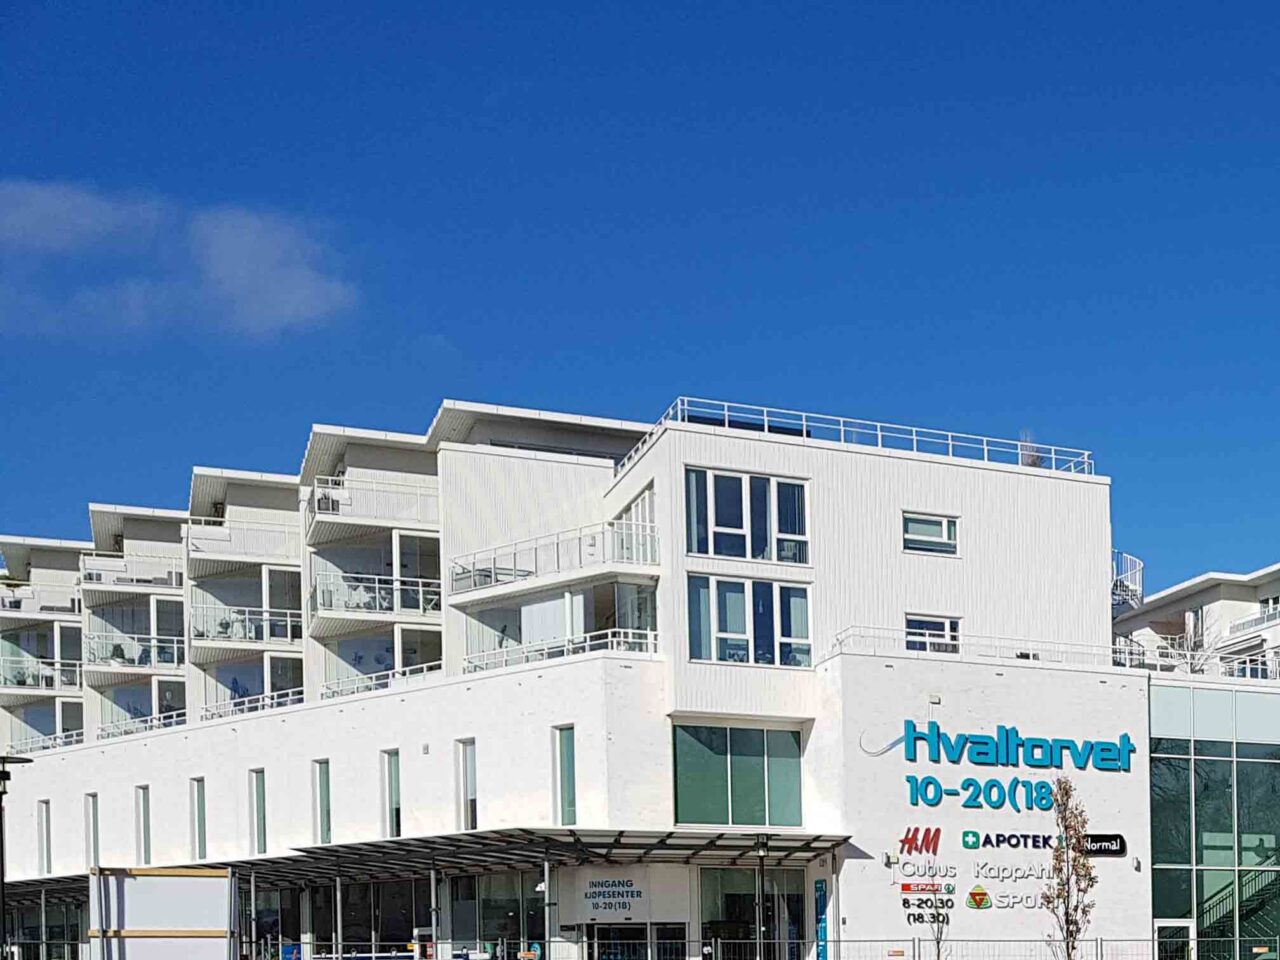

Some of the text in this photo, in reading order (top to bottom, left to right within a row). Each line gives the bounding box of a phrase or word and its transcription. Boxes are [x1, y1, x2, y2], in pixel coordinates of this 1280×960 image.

[903, 719, 1137, 773] Hvaltorvet
[905, 775, 1057, 814] 10-20(18
[899, 826, 942, 857] H&M
[981, 834, 1054, 850] APOTEK
[899, 858, 957, 879] Cubus
[588, 879, 634, 889] INNGANG
[591, 901, 631, 912] 10-20(18)
